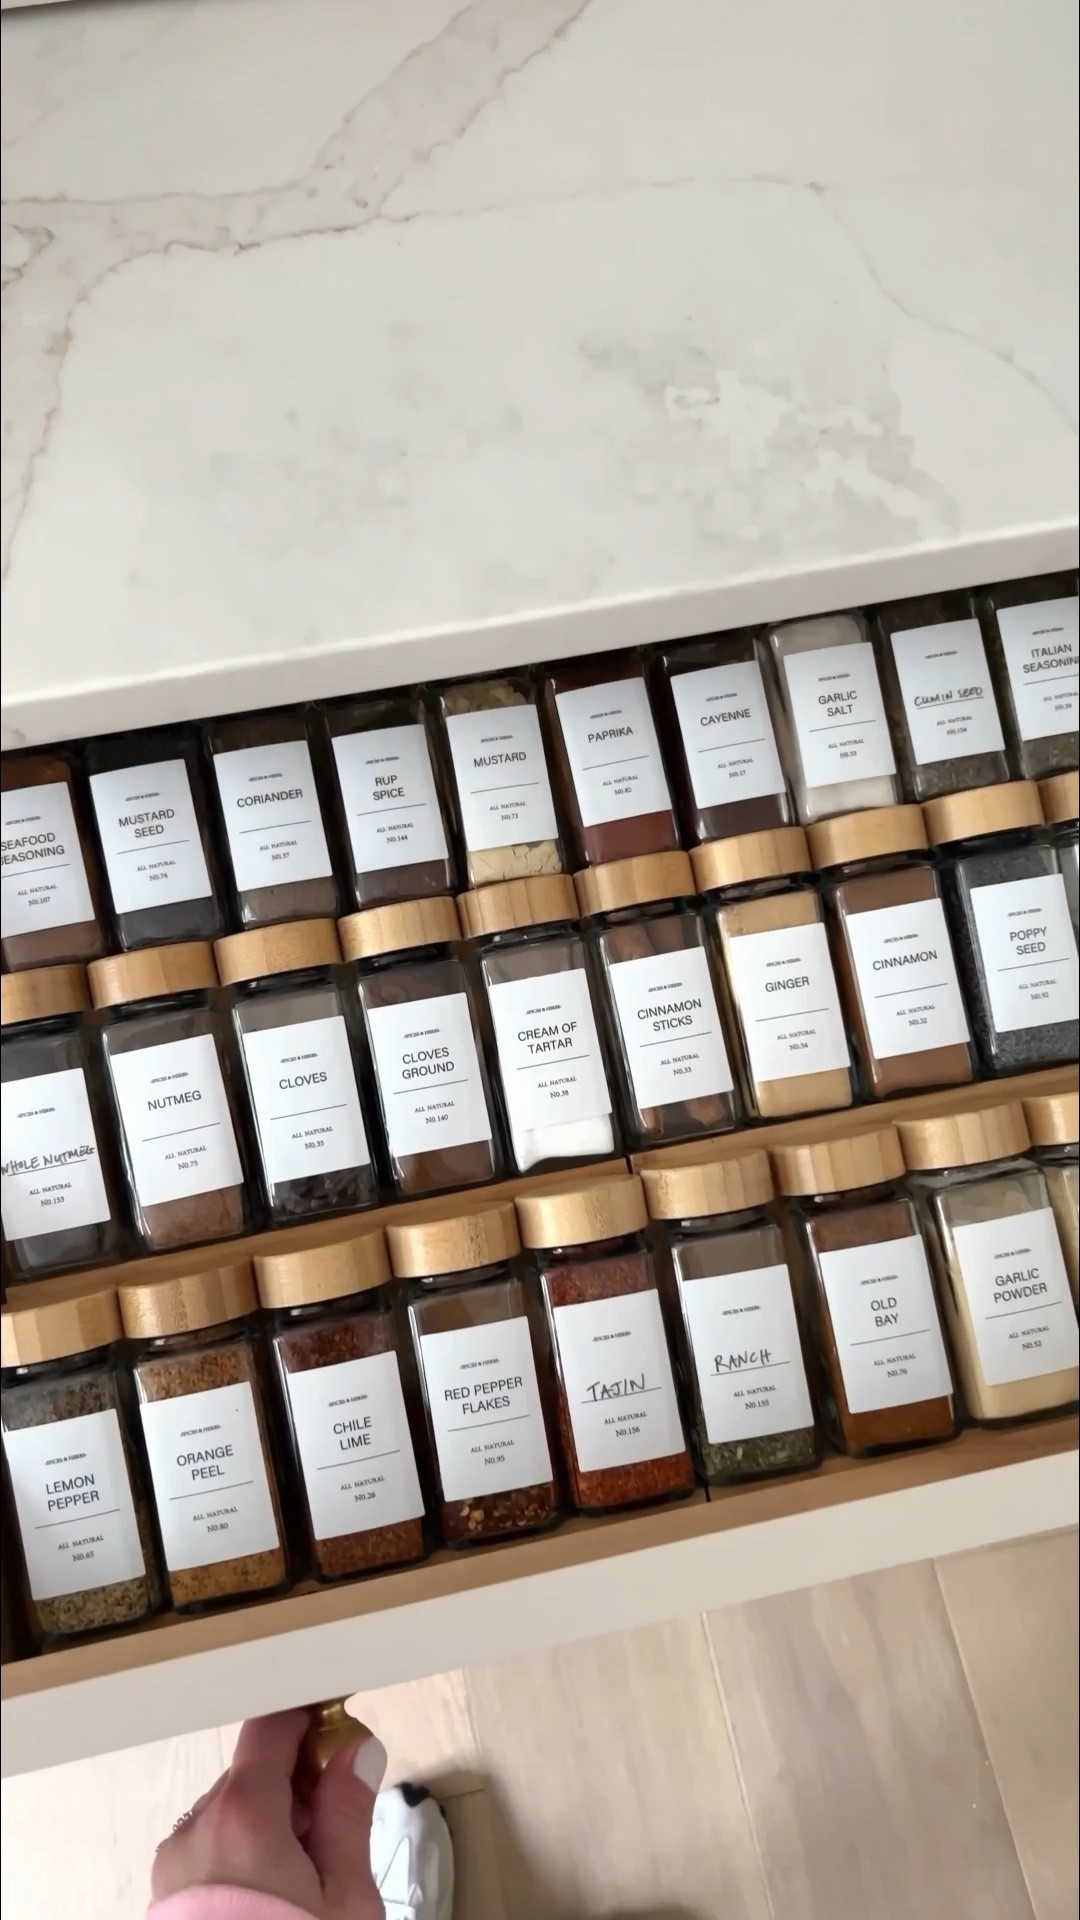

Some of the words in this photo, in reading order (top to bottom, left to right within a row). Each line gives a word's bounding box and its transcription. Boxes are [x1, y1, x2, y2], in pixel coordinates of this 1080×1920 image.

[1030, 642, 1072, 658] ITALIAN
[1022, 656, 1080, 674] SEASONIN
[818, 690, 858, 705] GARLIC
[700, 708, 752, 727] CAYENNE
[826, 704, 854, 717] SALT
[587, 726, 634, 744] PAPRIKA
[473, 751, 527, 768] MUSTARD
[374, 774, 398, 787] RUP
[613, 775, 639, 784] NATURAL
[236, 788, 304, 808] CORIANDER
[372, 786, 406, 801] SPICE
[500, 801, 526, 809] NATURAL
[118, 808, 175, 828] MUSTARD
[134, 824, 165, 839] SEED
[387, 822, 414, 832] NATURAL
[0, 832, 56, 852] SEAFOOD
[259, 844, 270, 852] ALL
[271, 840, 298, 849] NATURAL
[148, 860, 176, 869] NATURAL
[29, 884, 58, 894] NATURAL
[1009, 926, 1047, 942] POPPY
[1016, 941, 1046, 956] SEED
[872, 949, 938, 971] CINNAMON
[764, 976, 810, 993] GINGER
[1030, 979, 1057, 988] NATURAL
[637, 998, 702, 1020] CINNAMON
[907, 1004, 936, 1014] NATURAL
[517, 1024, 562, 1042] CREAM
[562, 1020, 578, 1034] OF
[652, 1014, 693, 1032] STICKS
[788, 1028, 816, 1038] NATURAL
[526, 1036, 573, 1055] TARTAR
[402, 1046, 450, 1065] CLOVES
[660, 1058, 672, 1066] ALL
[672, 1053, 700, 1064] NATURAL
[401, 1060, 455, 1080] GROUND
[278, 1071, 328, 1090] CLOVES
[549, 1076, 577, 1086] NATURAL
[147, 1090, 202, 1112] NUTMEG
[426, 1100, 456, 1112] NATURAL
[291, 1132, 304, 1140] ALL
[304, 1126, 334, 1137] NATURAL
[0, 1156, 42, 1176] WHOLE
[42, 1144, 96, 1167] NUTMEG
[164, 1152, 176, 1160] ALL
[177, 1145, 207, 1158] NATURAL
[29, 1188, 41, 1196] ALL
[41, 1182, 72, 1194] NATURAL
[994, 1268, 1040, 1287] GARLIC
[993, 1282, 1048, 1304] POWDER
[870, 1296, 898, 1312] OLD
[874, 1312, 899, 1328] BAY
[1021, 1325, 1050, 1337] NATURAL
[714, 1348, 772, 1373] RANCH
[886, 1353, 916, 1364] NATURAL
[444, 1386, 471, 1402] RED
[473, 1376, 523, 1396] PEPPER
[586, 1372, 646, 1402] TAJIN
[733, 1390, 746, 1398] ALL
[746, 1385, 777, 1396] NATURAL
[462, 1395, 511, 1415] FLAKES
[332, 1416, 372, 1435] CHILE
[604, 1417, 616, 1425] ALL
[617, 1411, 648, 1422] NATURAL
[339, 1432, 372, 1451] LIME
[470, 1446, 482, 1454] ALL
[484, 1439, 515, 1451] NATURAL
[176, 1444, 234, 1467] ORANGE
[191, 1464, 226, 1481] PEEL
[45, 1473, 95, 1495] LEMON
[340, 1483, 353, 1491] ALL
[354, 1475, 385, 1488] NATURAL
[47, 1490, 100, 1512] PEPPER
[192, 1513, 205, 1522] ALL
[206, 1506, 238, 1519] NATURAL
[58, 1542, 70, 1550] ALL
[72, 1535, 104, 1547] NATURAL
